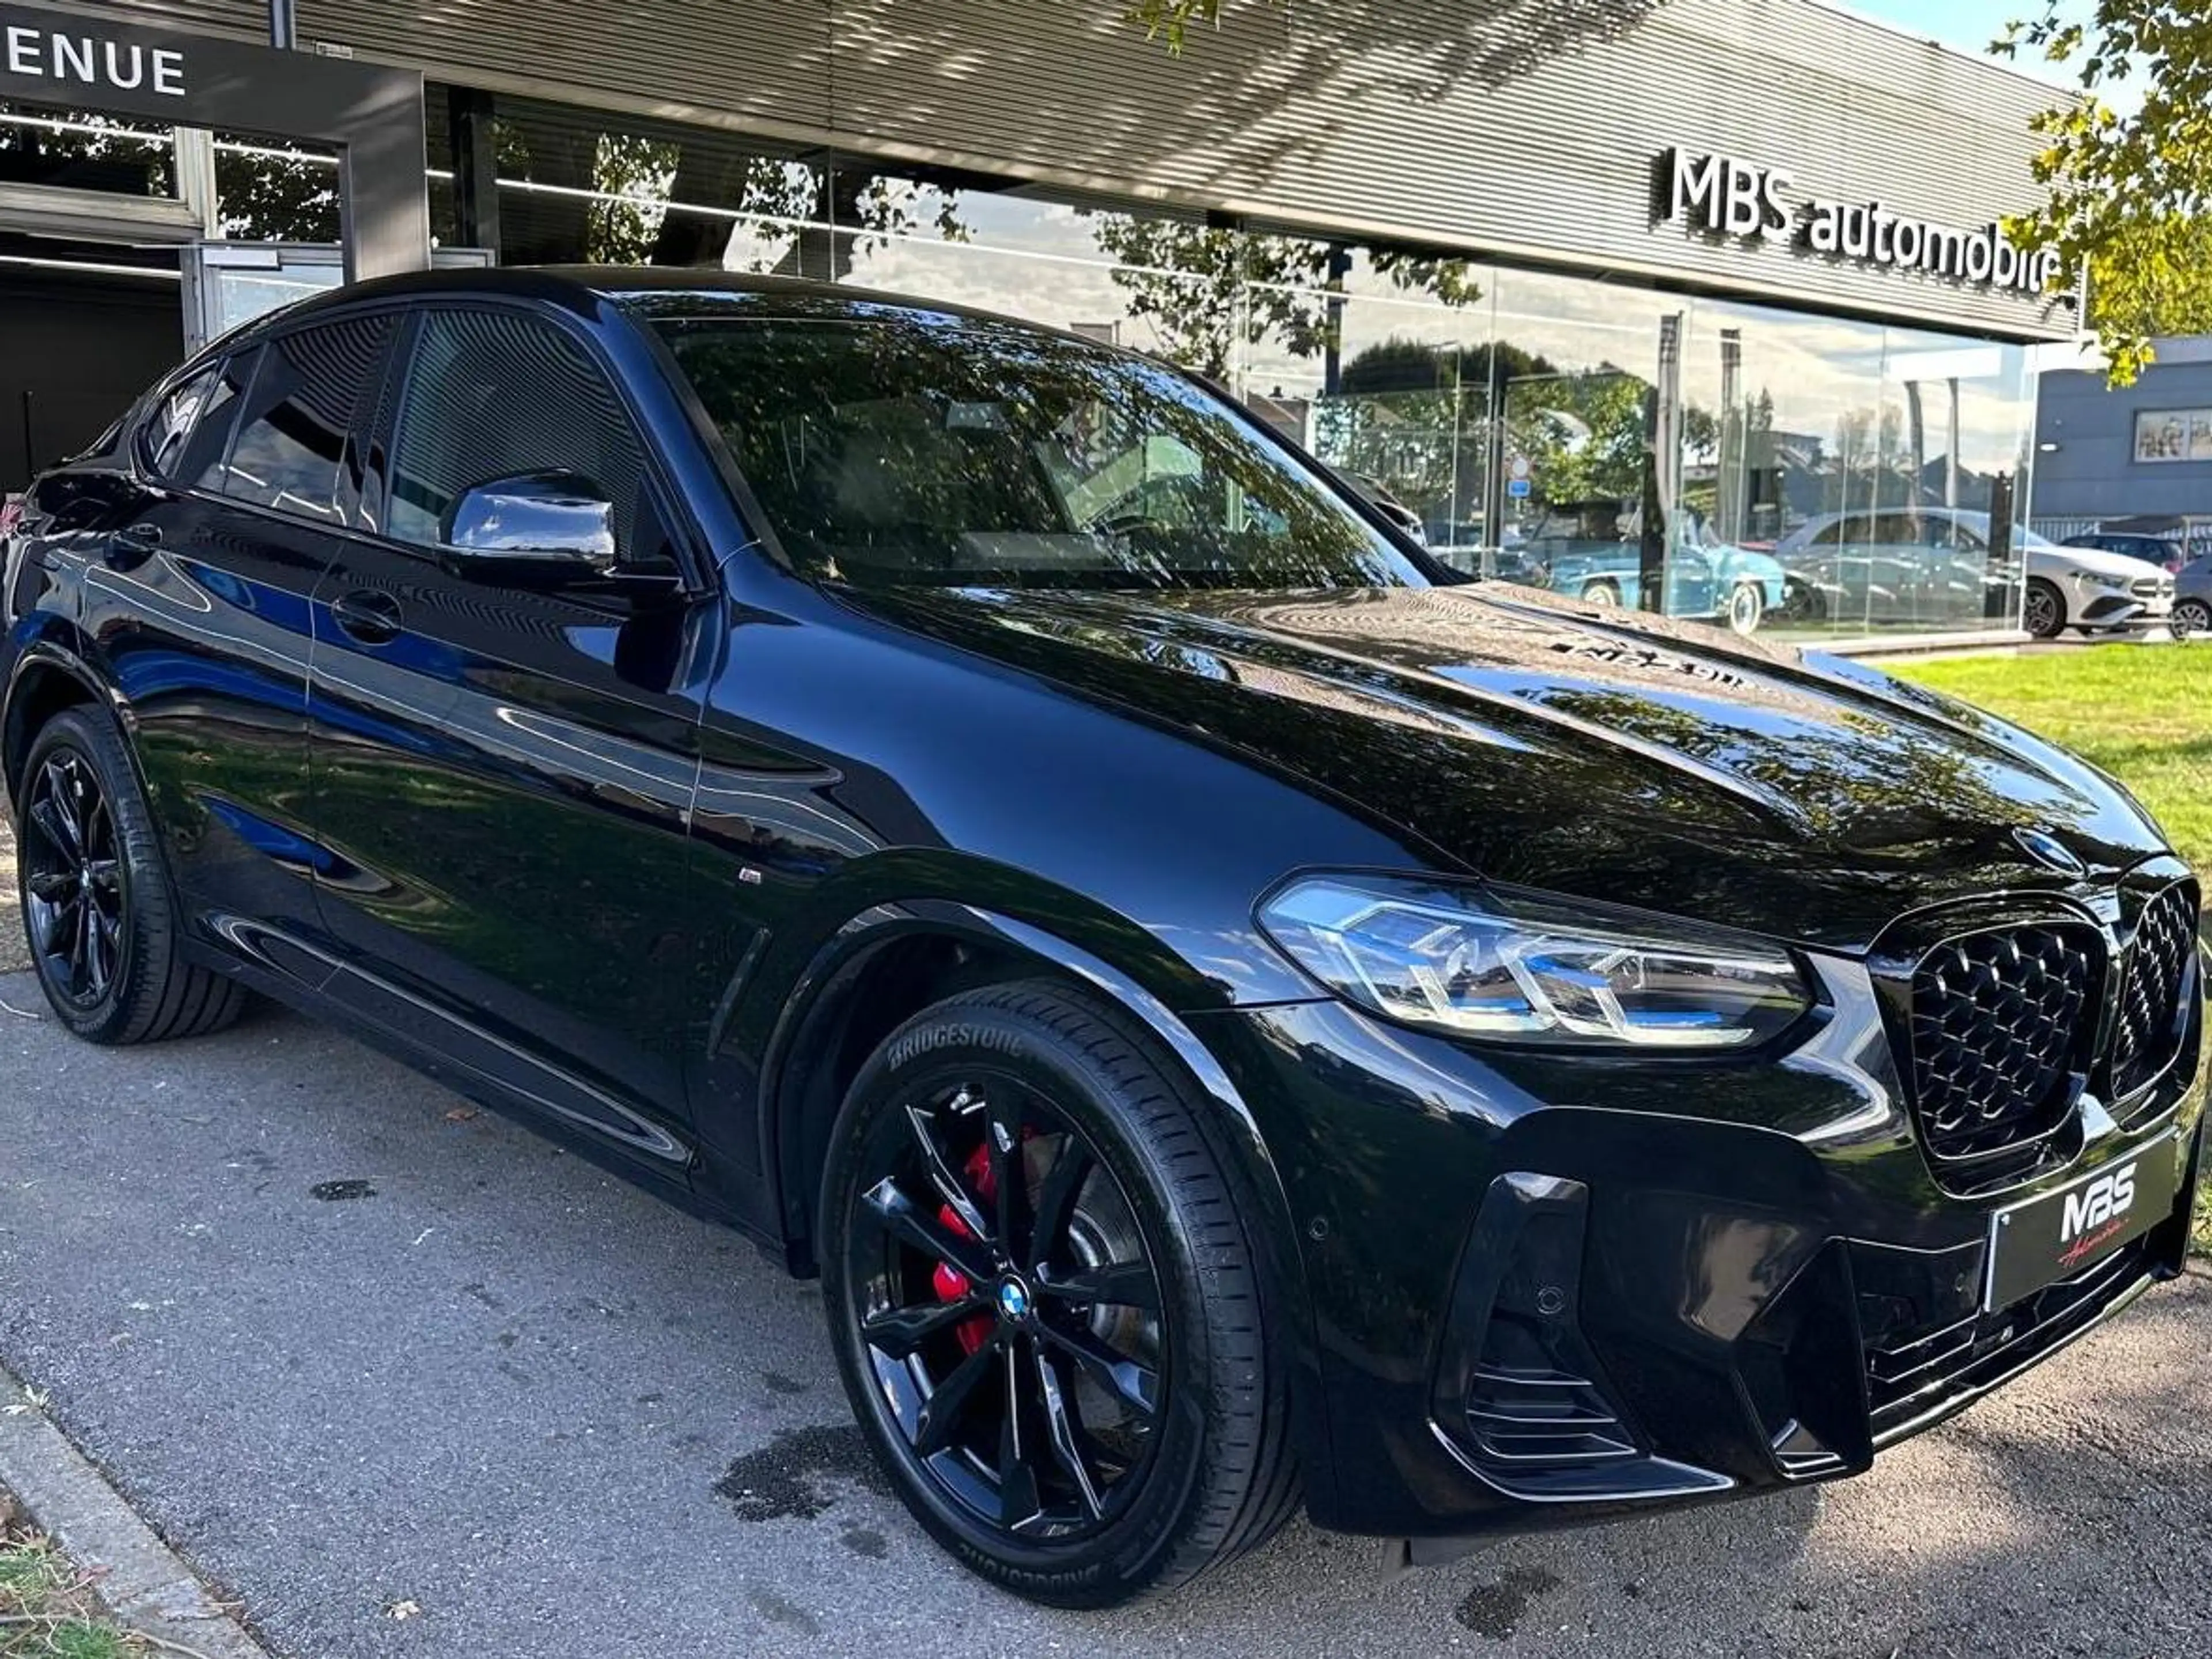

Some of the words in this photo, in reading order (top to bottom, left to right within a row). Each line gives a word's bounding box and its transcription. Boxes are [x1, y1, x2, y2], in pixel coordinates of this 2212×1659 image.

[7, 26, 185, 96] ENUE
[1671, 147, 1793, 243] MBS
[887, 1023, 1025, 1072] BRIDGESTONE
[2061, 1162, 2138, 1243] MBS
